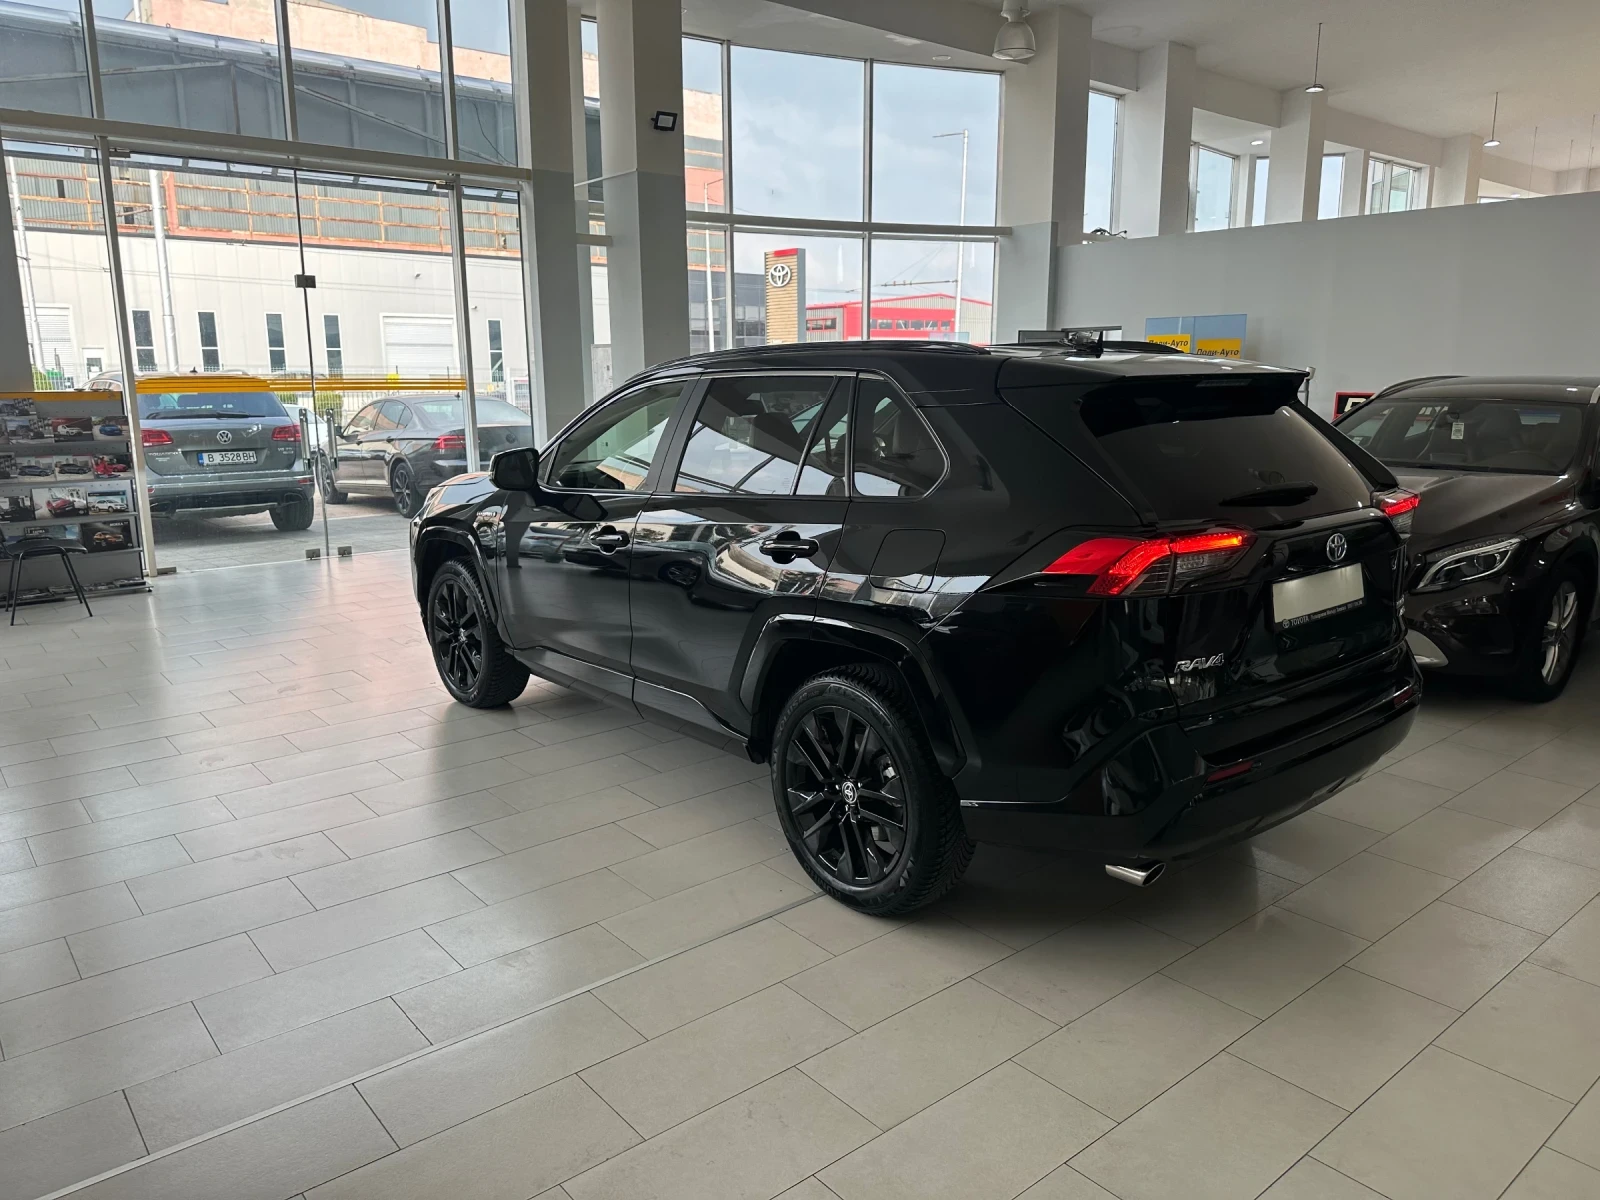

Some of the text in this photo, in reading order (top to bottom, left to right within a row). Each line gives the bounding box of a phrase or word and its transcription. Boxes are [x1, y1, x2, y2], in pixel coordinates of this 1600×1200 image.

[219, 452, 242, 462] 3528
[1291, 615, 1310, 627] TOYOTA
[1174, 652, 1224, 674] RAV4
